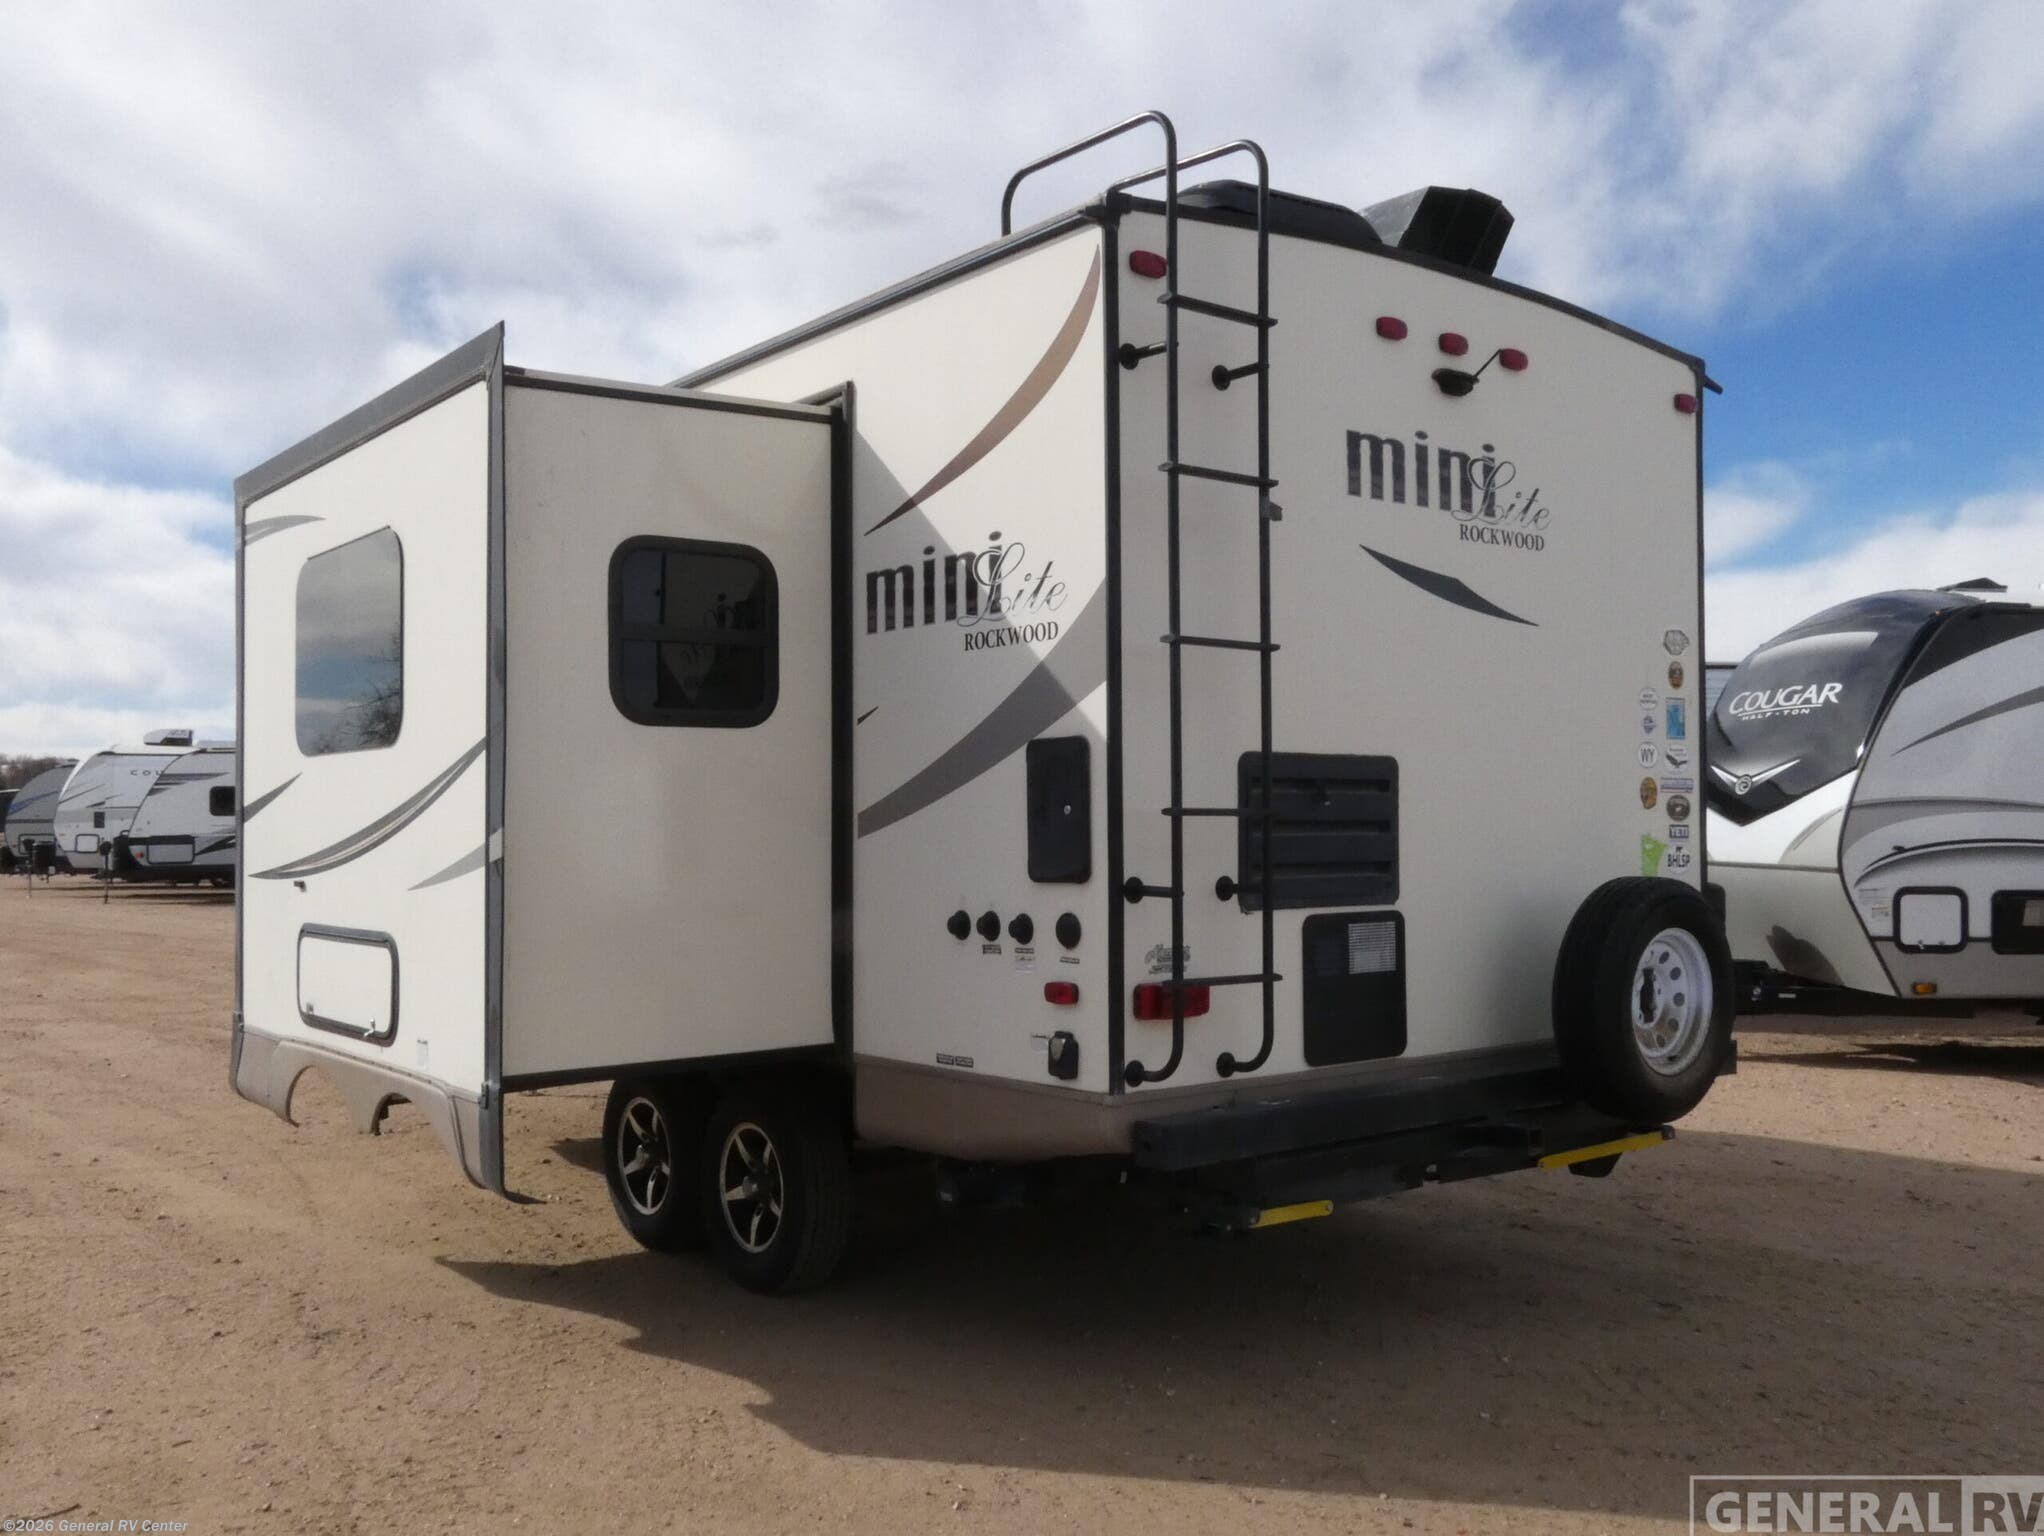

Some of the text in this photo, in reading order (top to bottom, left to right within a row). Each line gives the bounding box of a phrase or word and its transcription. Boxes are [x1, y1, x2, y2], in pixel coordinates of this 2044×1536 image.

[1347, 430, 1552, 530] mini Lite
[1459, 524, 1545, 551] ROCKWOOD
[866, 531, 1068, 634] mini Lite
[964, 621, 1059, 651] ROCKWOOD
[1729, 683, 1843, 714] COUGAR
